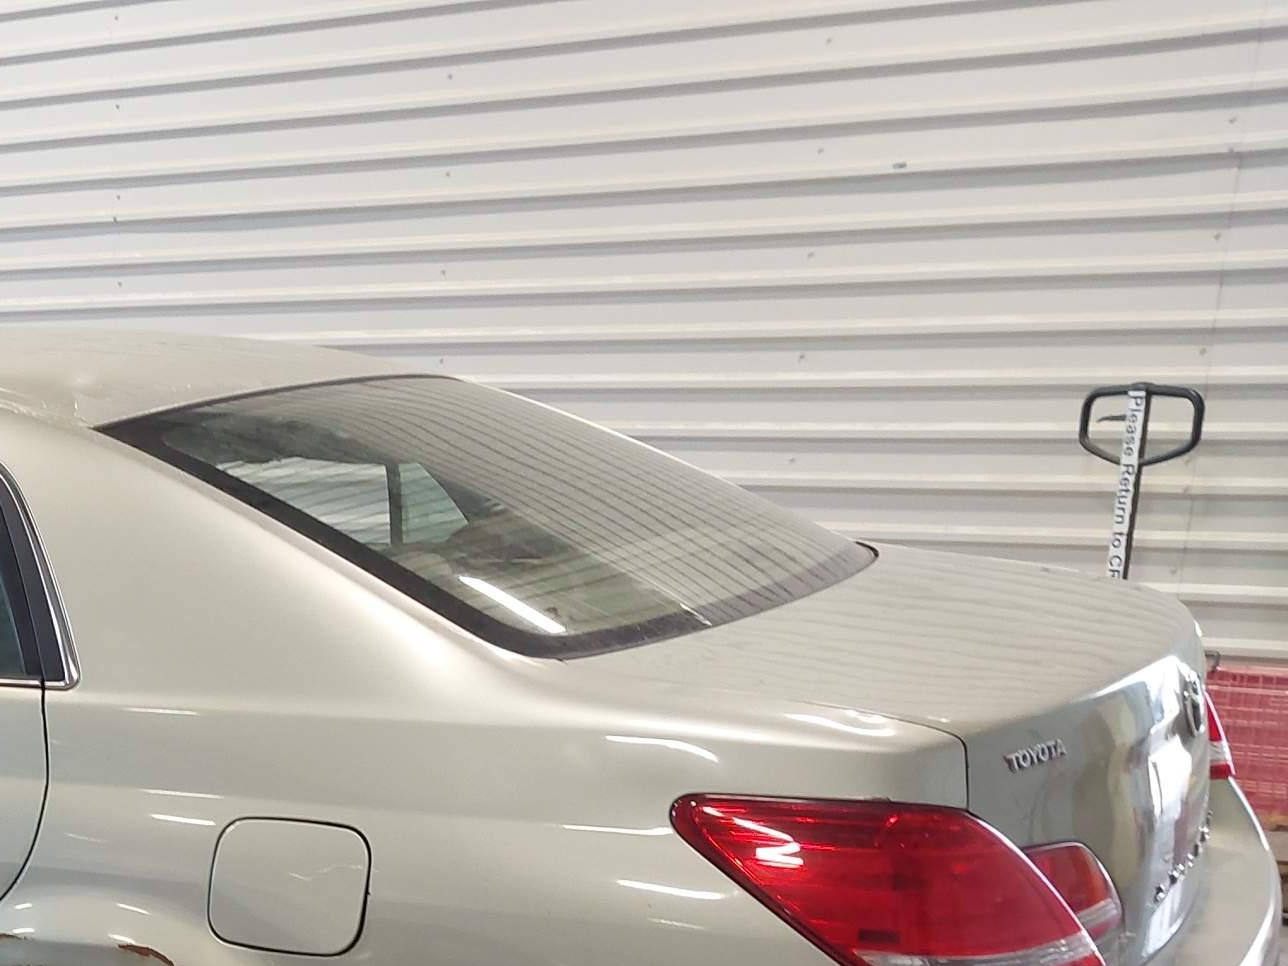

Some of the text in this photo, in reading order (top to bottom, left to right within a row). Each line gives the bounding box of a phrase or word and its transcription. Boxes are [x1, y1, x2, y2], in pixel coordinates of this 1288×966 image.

[1123, 391, 1143, 457] Please
[1114, 464, 1136, 525] Return
[1111, 532, 1127, 549] to
[1003, 737, 1067, 773] TOYOTA
